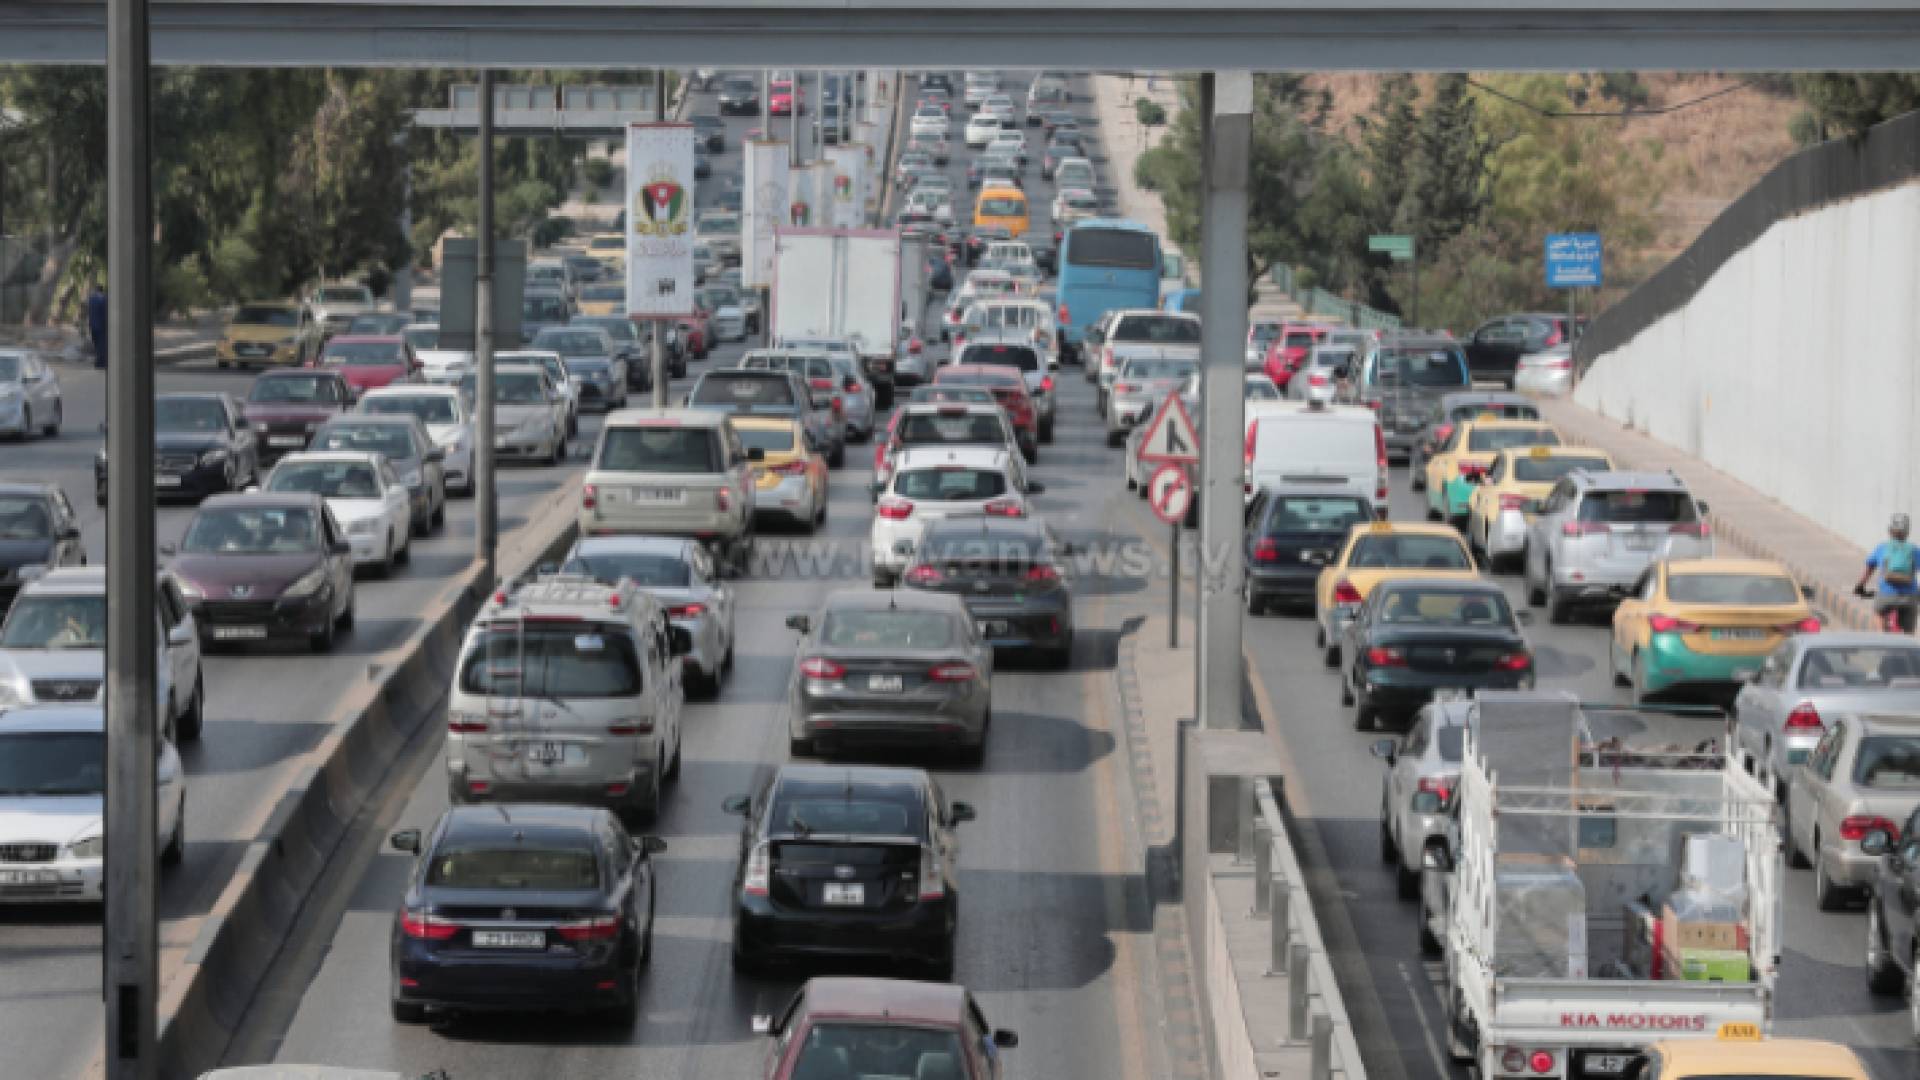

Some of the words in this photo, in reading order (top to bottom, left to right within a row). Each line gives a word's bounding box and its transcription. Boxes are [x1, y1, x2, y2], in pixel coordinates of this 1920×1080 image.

[1560, 1012, 1599, 1027] KIA
[1606, 1013, 1705, 1030] MOTORS
[1723, 1024, 1754, 1039] TAXI
